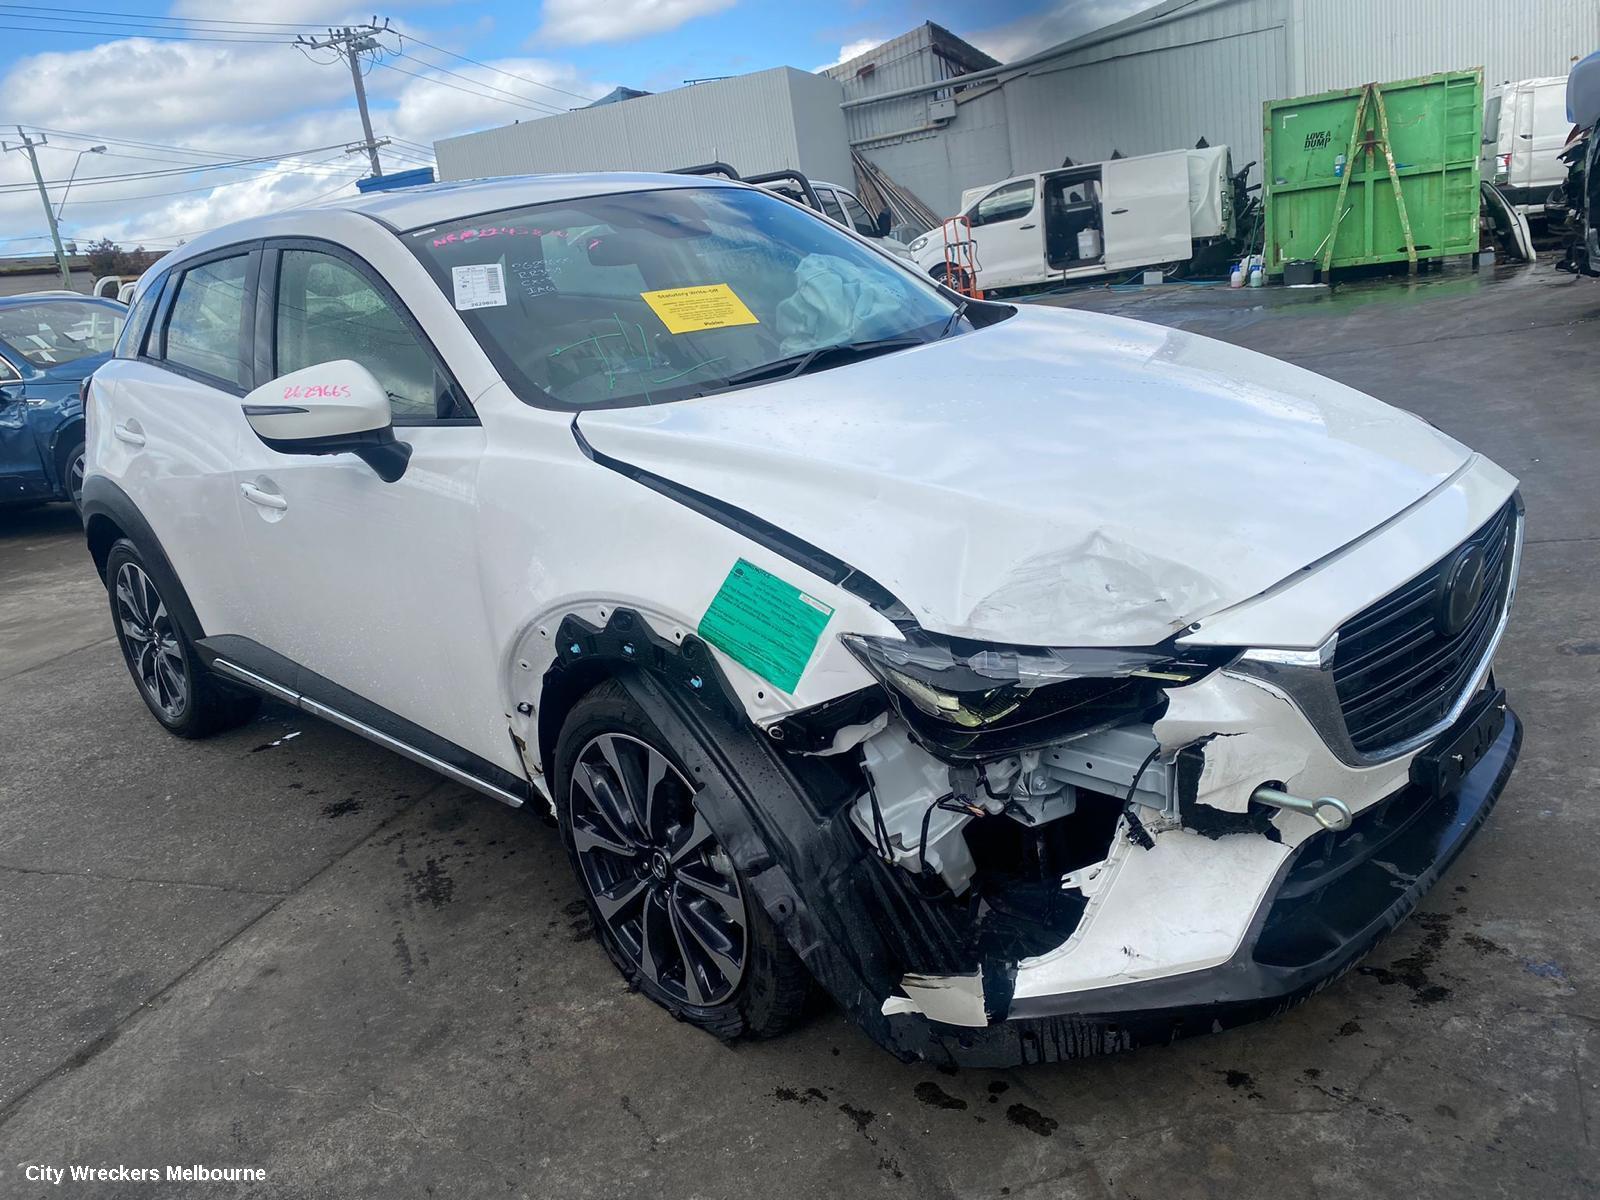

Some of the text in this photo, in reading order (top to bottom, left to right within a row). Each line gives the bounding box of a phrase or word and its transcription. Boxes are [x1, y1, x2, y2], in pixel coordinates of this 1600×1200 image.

[1306, 130, 1331, 140] LOVE A
[1304, 138, 1331, 149] DUMP
[657, 290, 689, 300] Statutory
